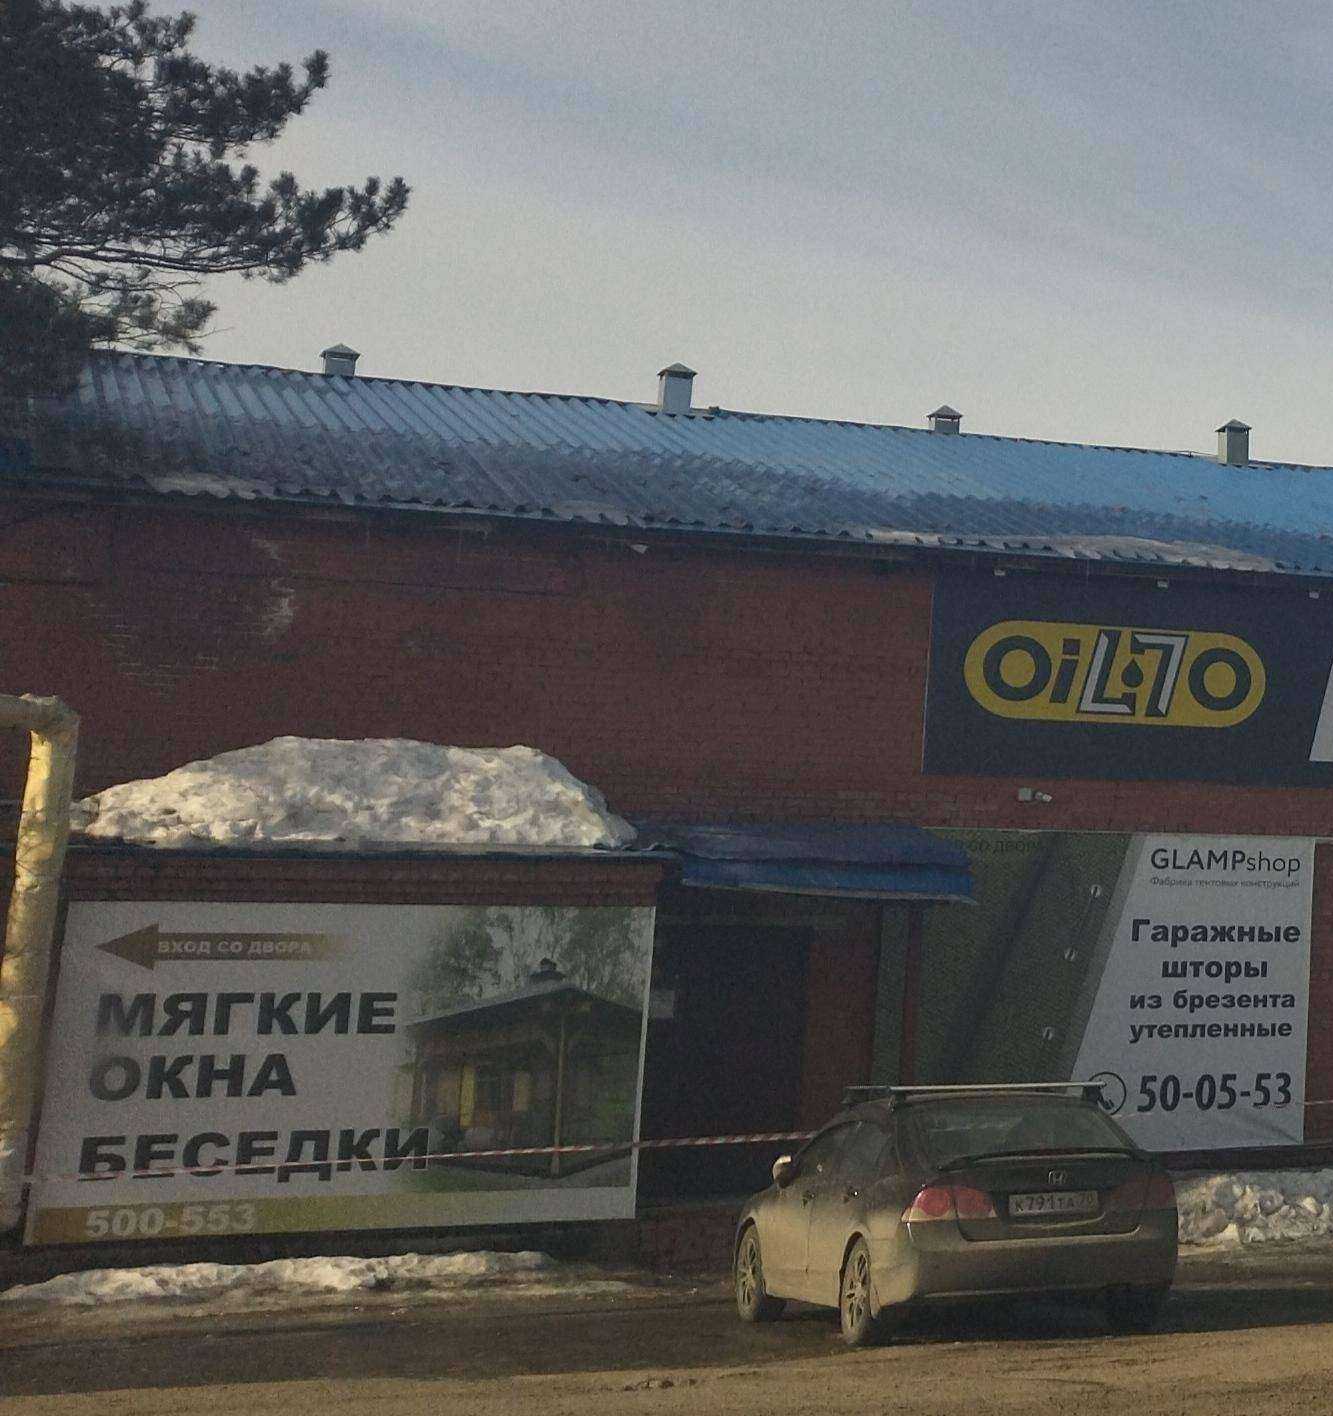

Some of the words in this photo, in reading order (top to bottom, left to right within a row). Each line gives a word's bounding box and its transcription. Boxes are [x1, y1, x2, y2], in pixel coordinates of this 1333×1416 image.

[1150, 848, 1301, 877] GLAMPshop
[157, 941, 211, 954] ВХОД
[217, 941, 244, 953] СО
[249, 941, 314, 955] ДВОРА
[1130, 918, 1301, 948] Гаражные
[1161, 958, 1268, 983] шторы
[96, 991, 398, 1037] МЯГКИЕ
[1129, 993, 1163, 1009] из
[1173, 989, 1296, 1013] брезента
[1128, 1020, 1293, 1044] утепленные
[88, 1053, 297, 1101] ОКНА
[1136, 1072, 1293, 1113] 50-05-53
[78, 1127, 431, 1183] БЕСЕДКИ
[85, 1204, 257, 1239] 500-553
